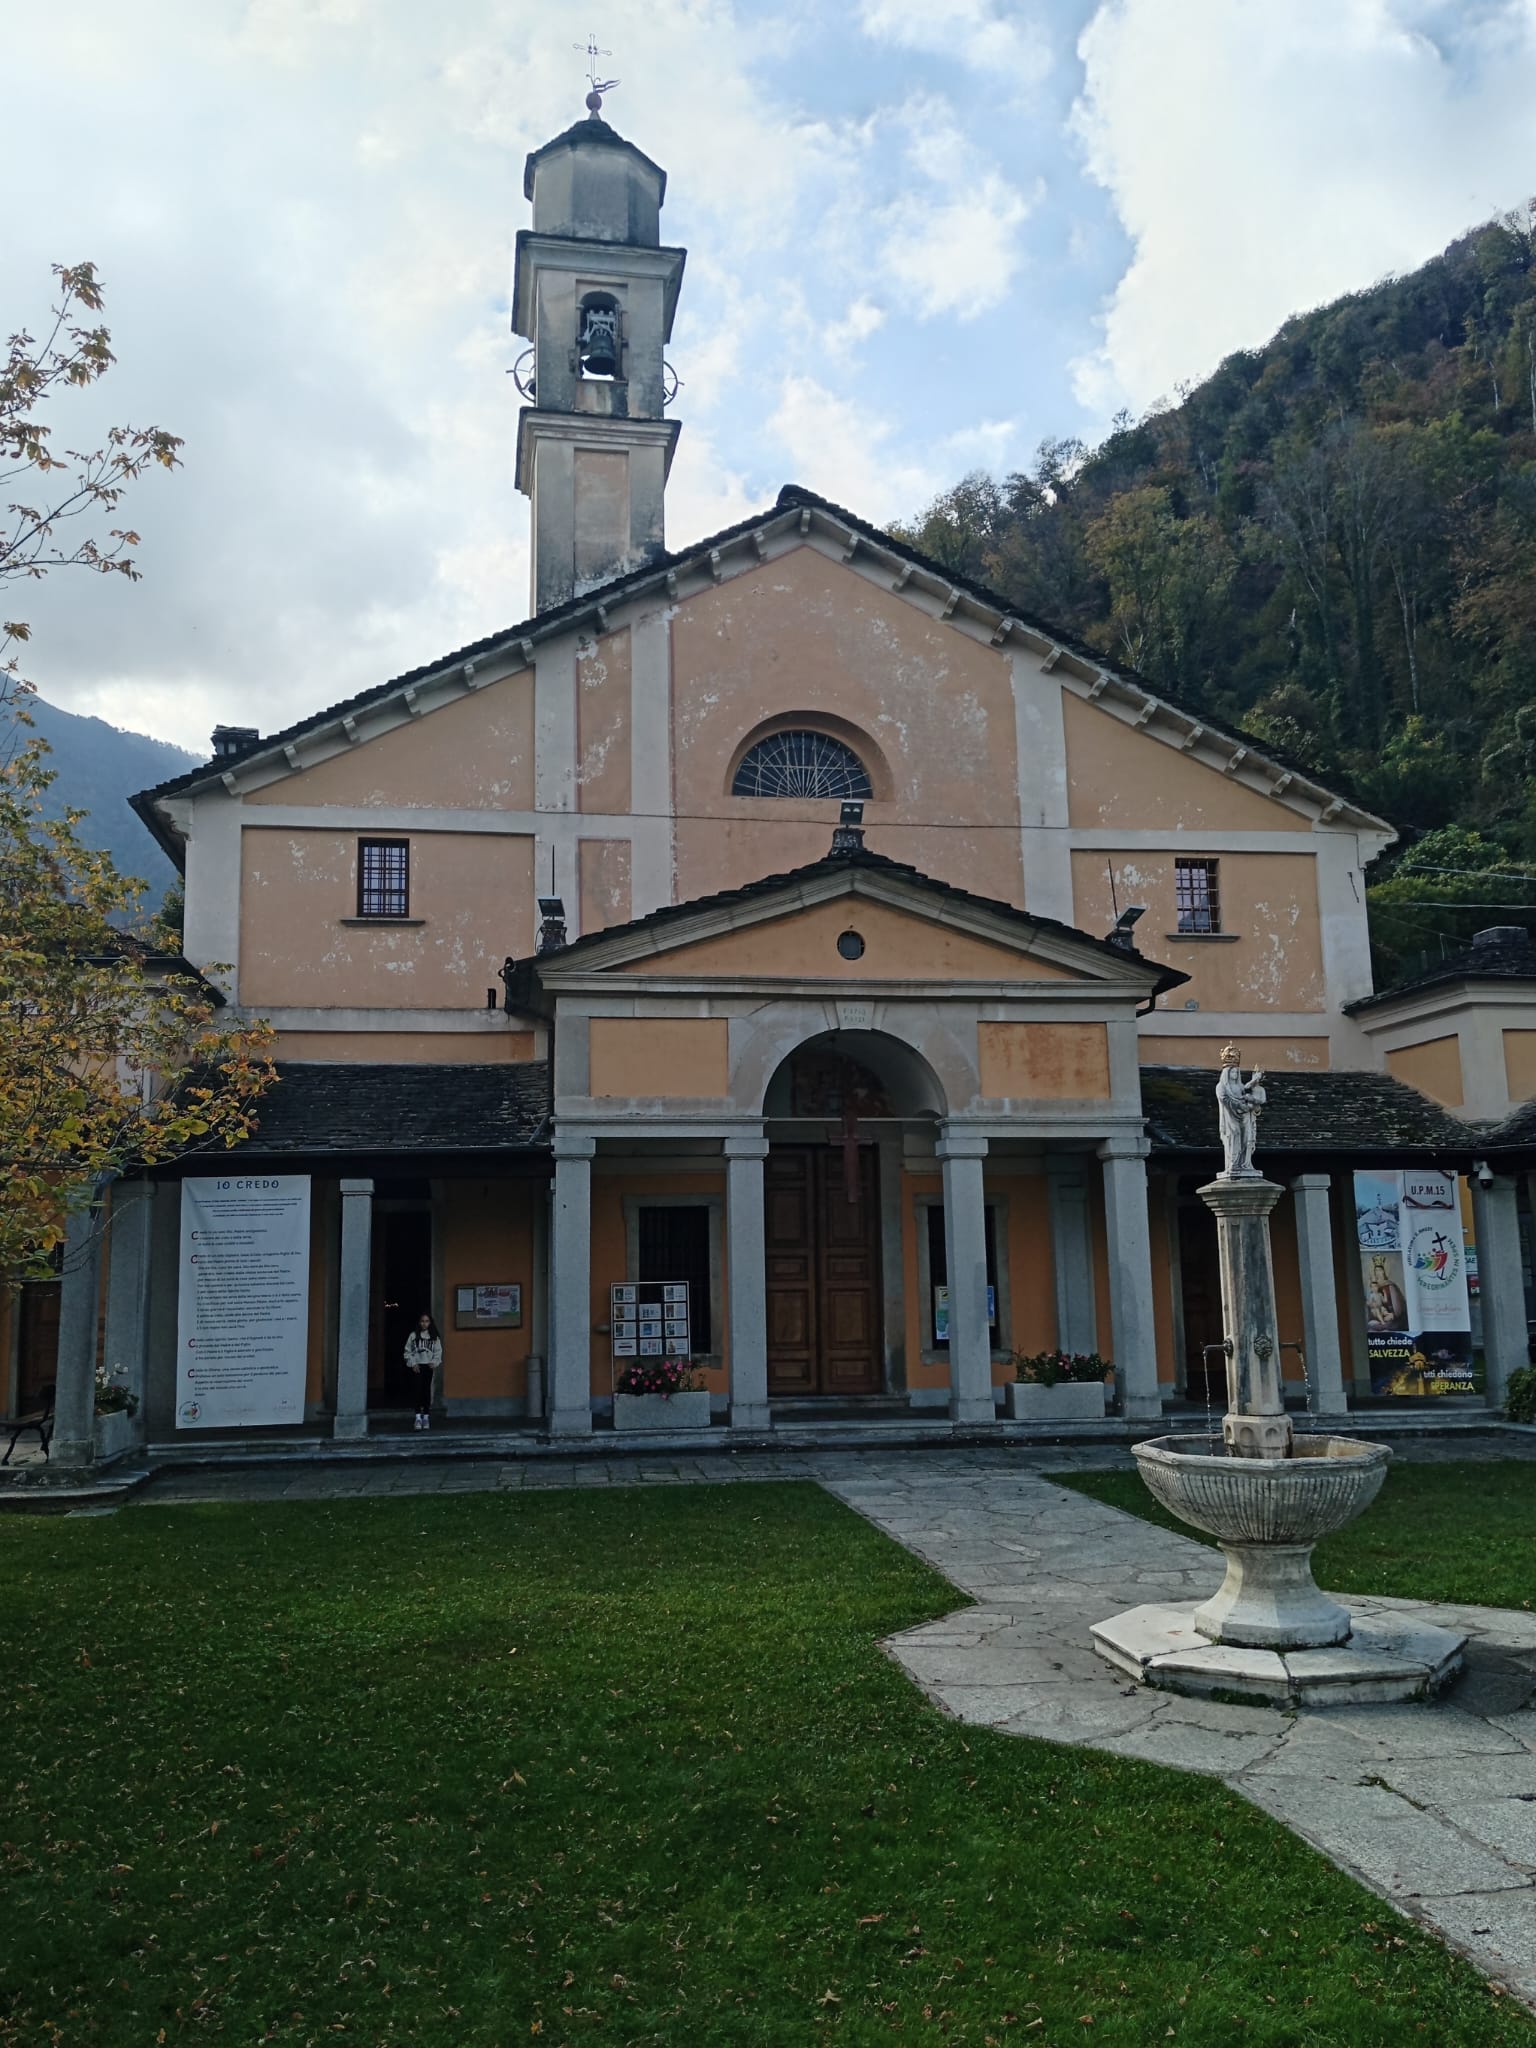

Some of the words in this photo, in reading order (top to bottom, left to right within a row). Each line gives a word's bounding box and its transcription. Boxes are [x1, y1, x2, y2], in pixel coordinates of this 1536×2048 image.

[216, 1181, 230, 1190] IO
[236, 1180, 280, 1190] CREDO
[1411, 1185, 1445, 1195] U.P.M.15
[1368, 1337, 1386, 1346] tutto
[1386, 1336, 1413, 1346] chiede
[1368, 1348, 1410, 1358] SALVEZZA
[1436, 1369, 1473, 1378] chiedono
[1430, 1381, 1474, 1391] SPERANZA
